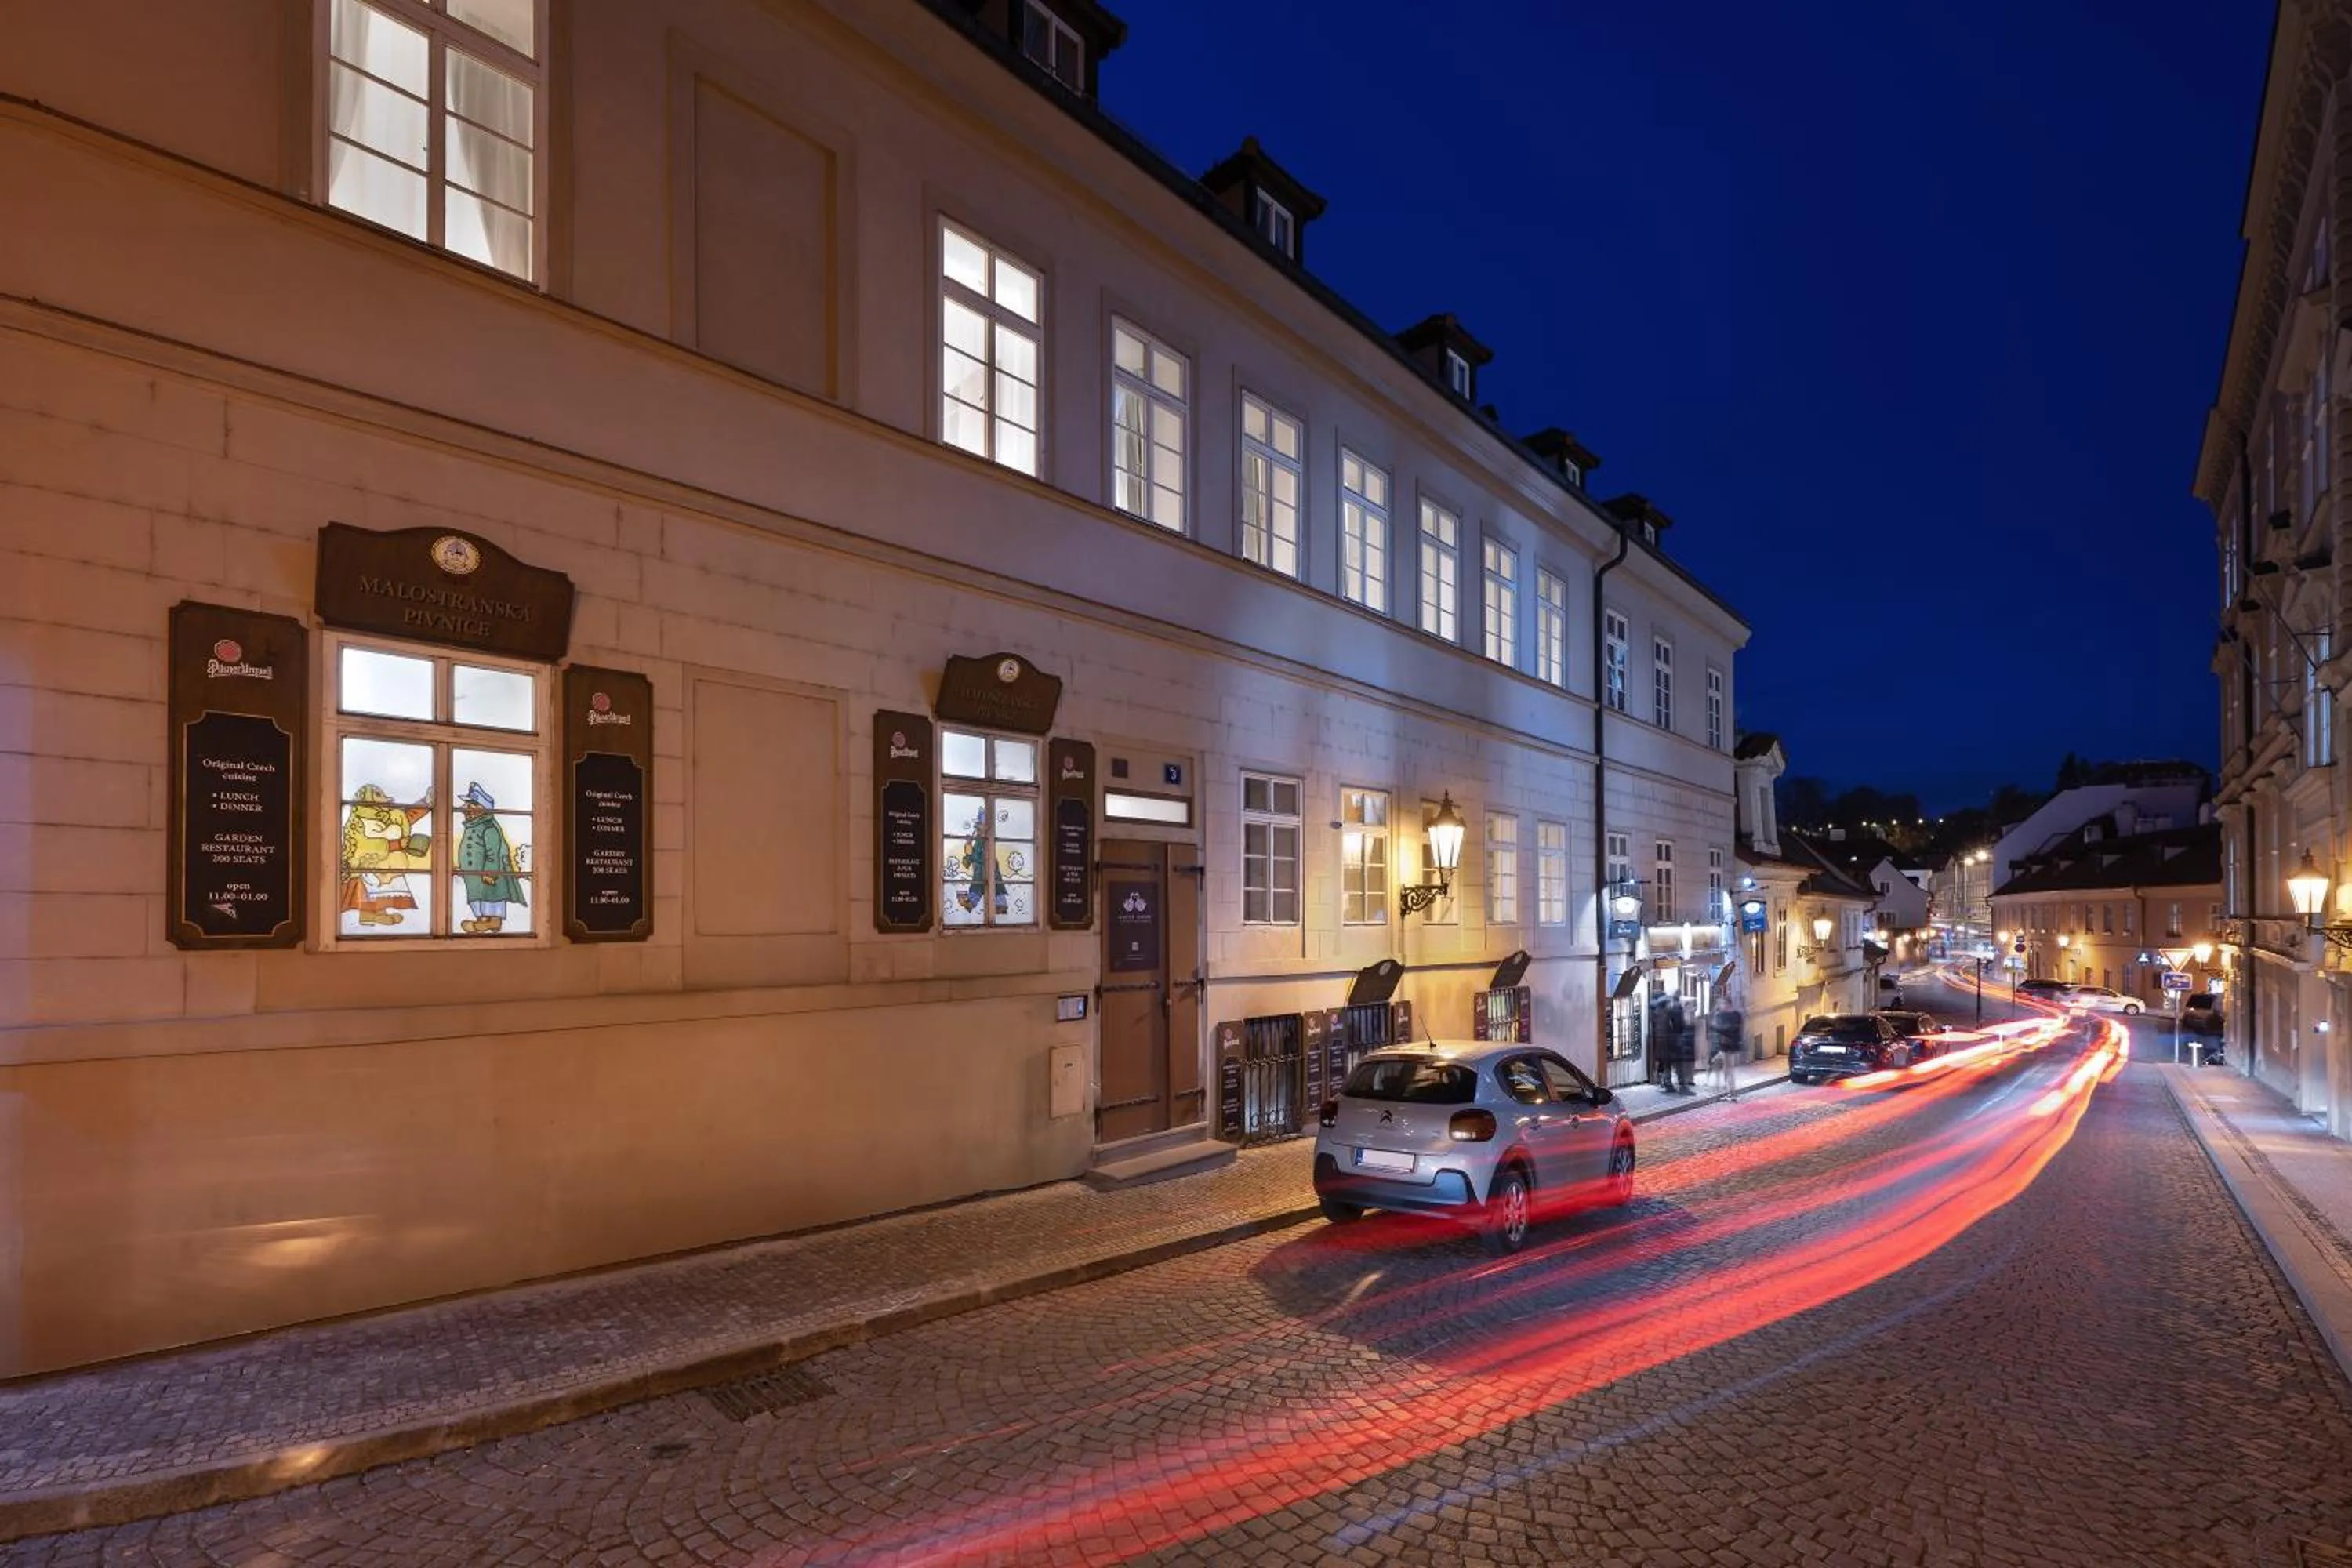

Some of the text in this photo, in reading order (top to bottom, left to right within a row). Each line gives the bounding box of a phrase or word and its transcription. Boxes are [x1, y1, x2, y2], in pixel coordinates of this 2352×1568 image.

[202, 759, 275, 772] Original Czech
[220, 791, 259, 800] LUNCH
[220, 802, 263, 812] DINNER
[214, 833, 263, 843] GARDEN
[201, 843, 276, 854] RESTAURANT
[233, 855, 267, 864] SEATS
[226, 883, 251, 891] open
